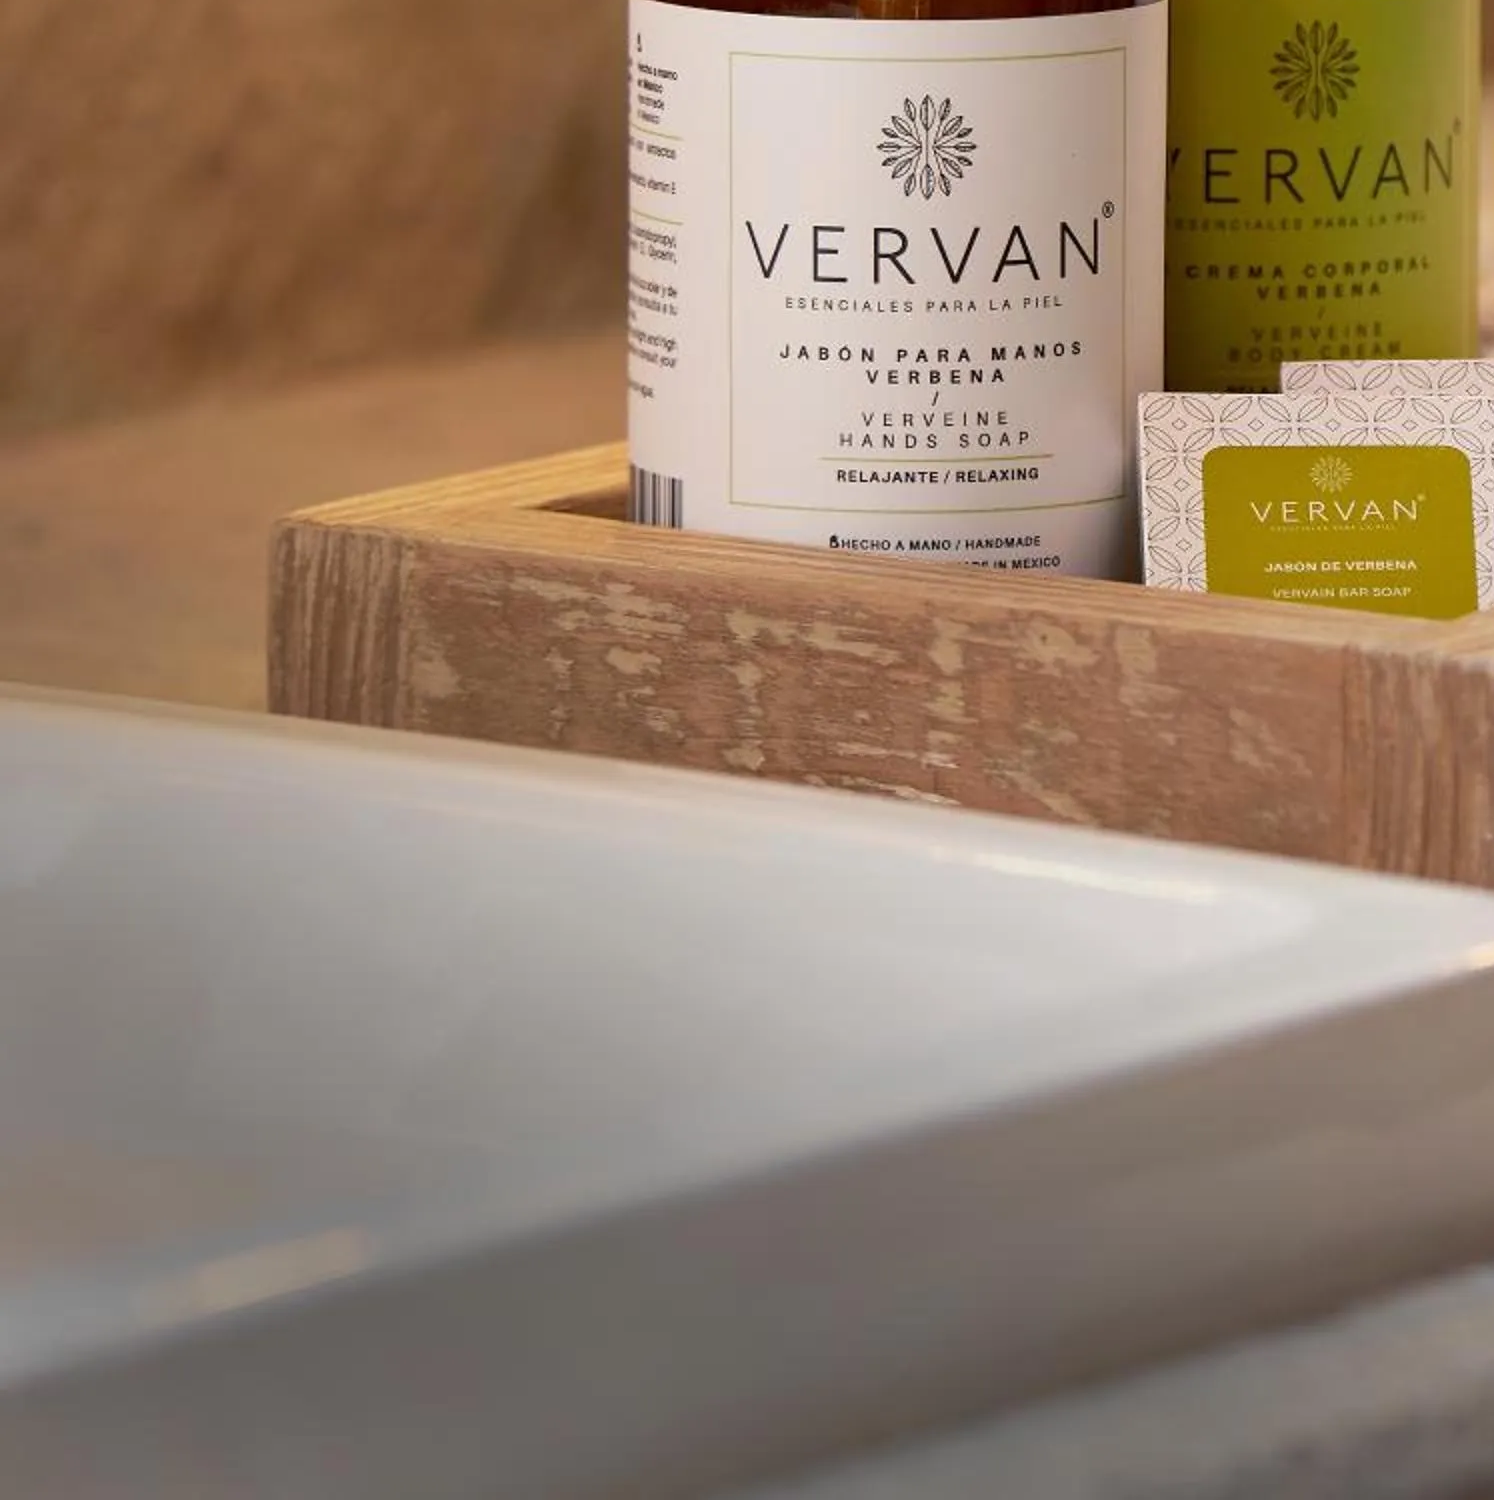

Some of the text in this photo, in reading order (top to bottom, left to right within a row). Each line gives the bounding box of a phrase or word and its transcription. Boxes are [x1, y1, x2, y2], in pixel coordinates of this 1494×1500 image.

[1185, 255, 1430, 280] CREMA CORPORAL
[1256, 281, 1381, 301] VERBENA
[785, 296, 1063, 313] ESENCIALES PARA LA PIEL
[779, 341, 1082, 363] JABÓN PARA MANOS
[865, 368, 1005, 385] VERBENA
[861, 411, 1009, 427] VERVEINE
[838, 431, 1030, 449] HANDS SOAP
[836, 469, 939, 483] RELAJANTE
[955, 467, 1040, 483] RELAXING
[841, 539, 891, 551] HECHO
[896, 540, 905, 551] A
[909, 539, 951, 551] MANO
[965, 535, 1041, 550] HANDMADE
[1321, 561, 1341, 571] DE
[1345, 560, 1417, 571] VERBENA
[1373, 586, 1412, 597] SOAP
